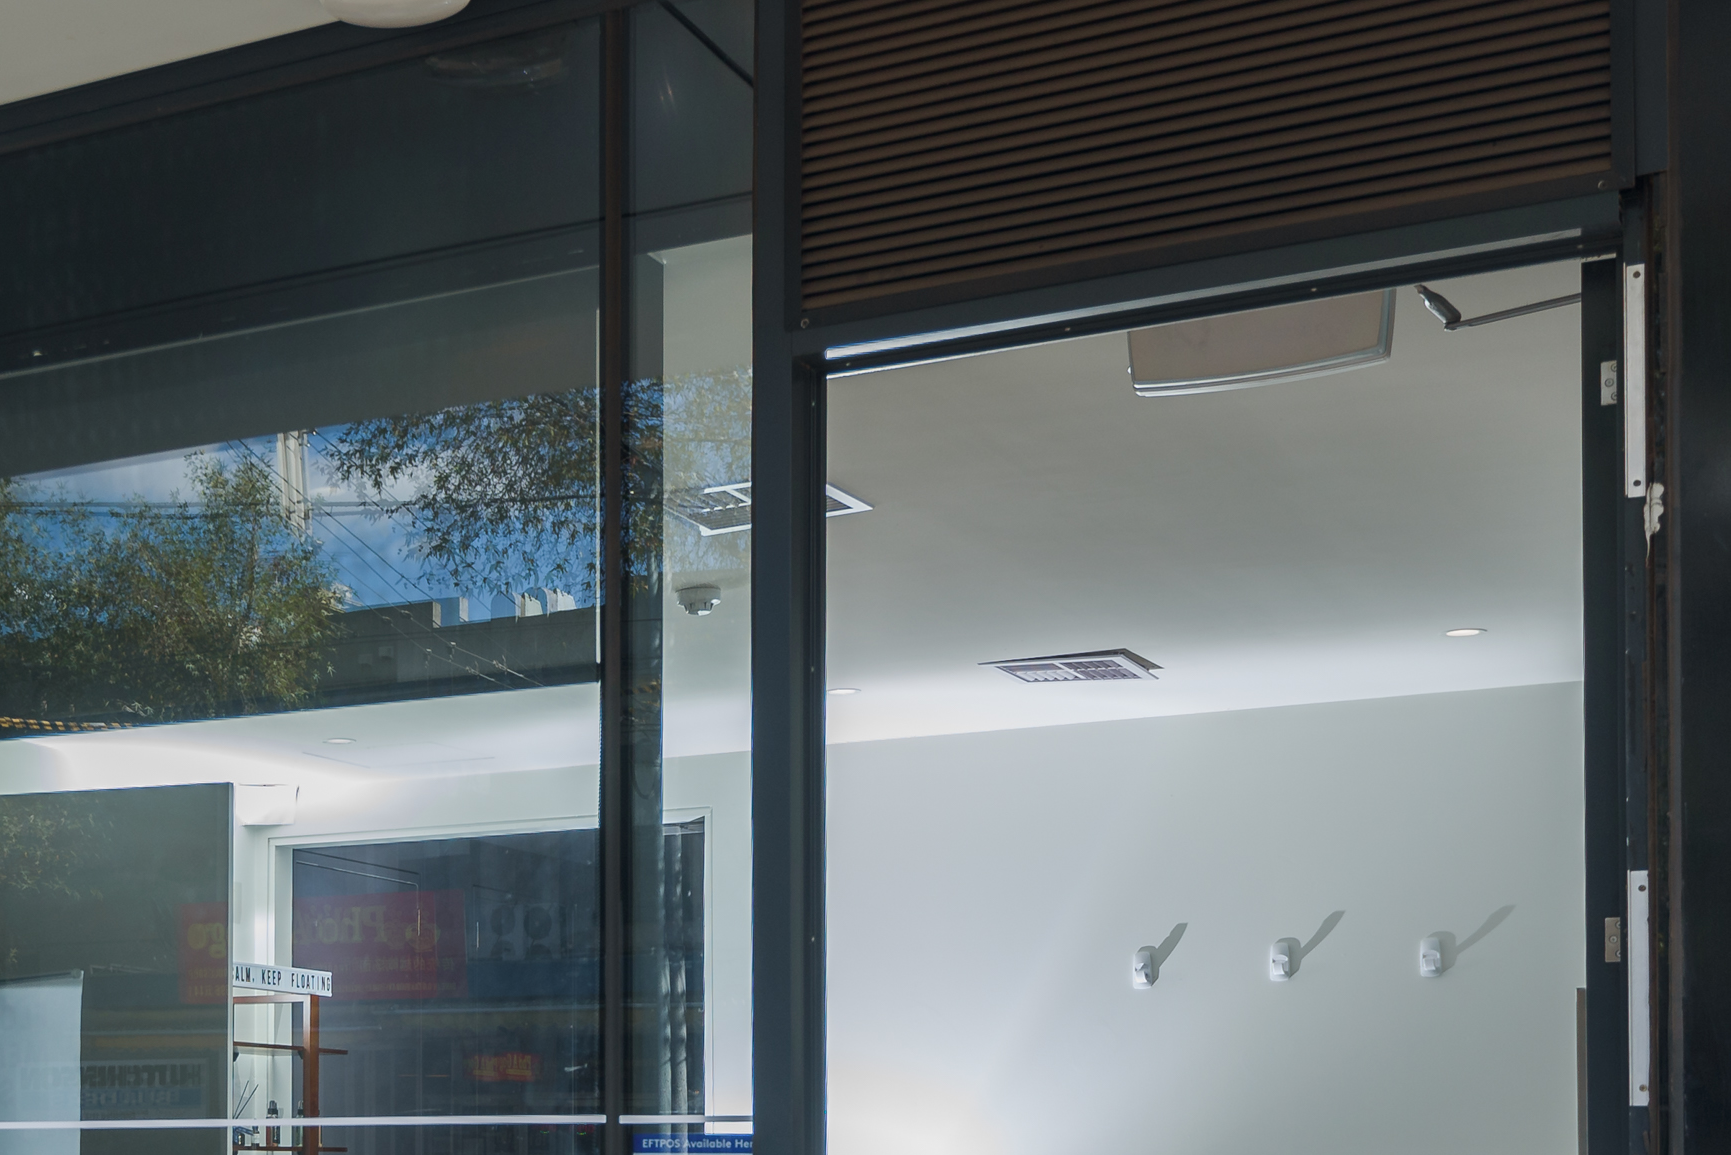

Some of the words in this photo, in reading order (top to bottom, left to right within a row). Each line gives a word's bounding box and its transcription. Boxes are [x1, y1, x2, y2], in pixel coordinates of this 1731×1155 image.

[232, 965, 255, 983] ALM,
[261, 968, 282, 986] KEEP
[291, 972, 331, 992] FLOATING
[642, 1138, 681, 1149] EFTPOS
[683, 1138, 732, 1149] Available
